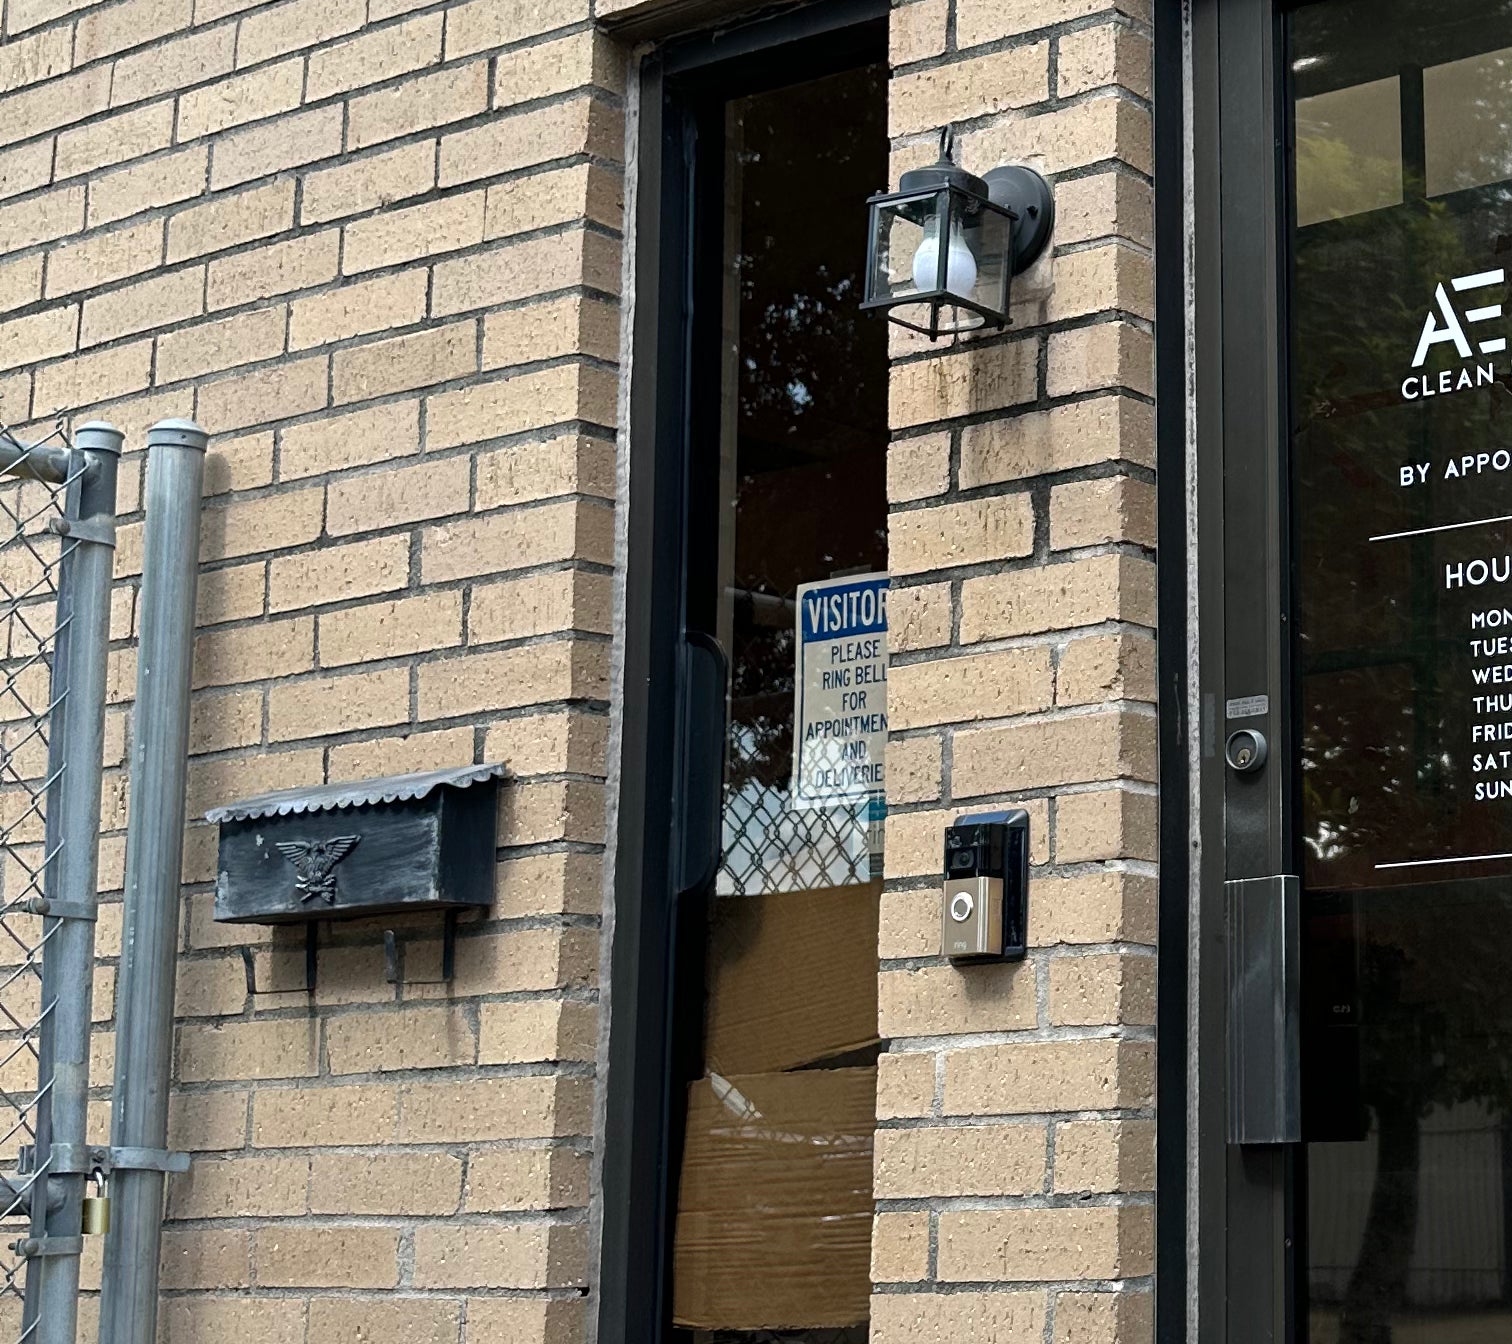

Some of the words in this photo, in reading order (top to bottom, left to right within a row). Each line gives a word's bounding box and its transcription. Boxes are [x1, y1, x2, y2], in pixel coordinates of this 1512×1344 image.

[1400, 363, 1496, 401] CLEAN
[1399, 462, 1432, 488] BY
[831, 639, 881, 665] PLEASE
[822, 667, 851, 691] RING
[855, 662, 888, 686] BELL
[842, 690, 867, 712] FOR
[841, 740, 867, 761] AND
[815, 763, 885, 789] DELIVERIE
